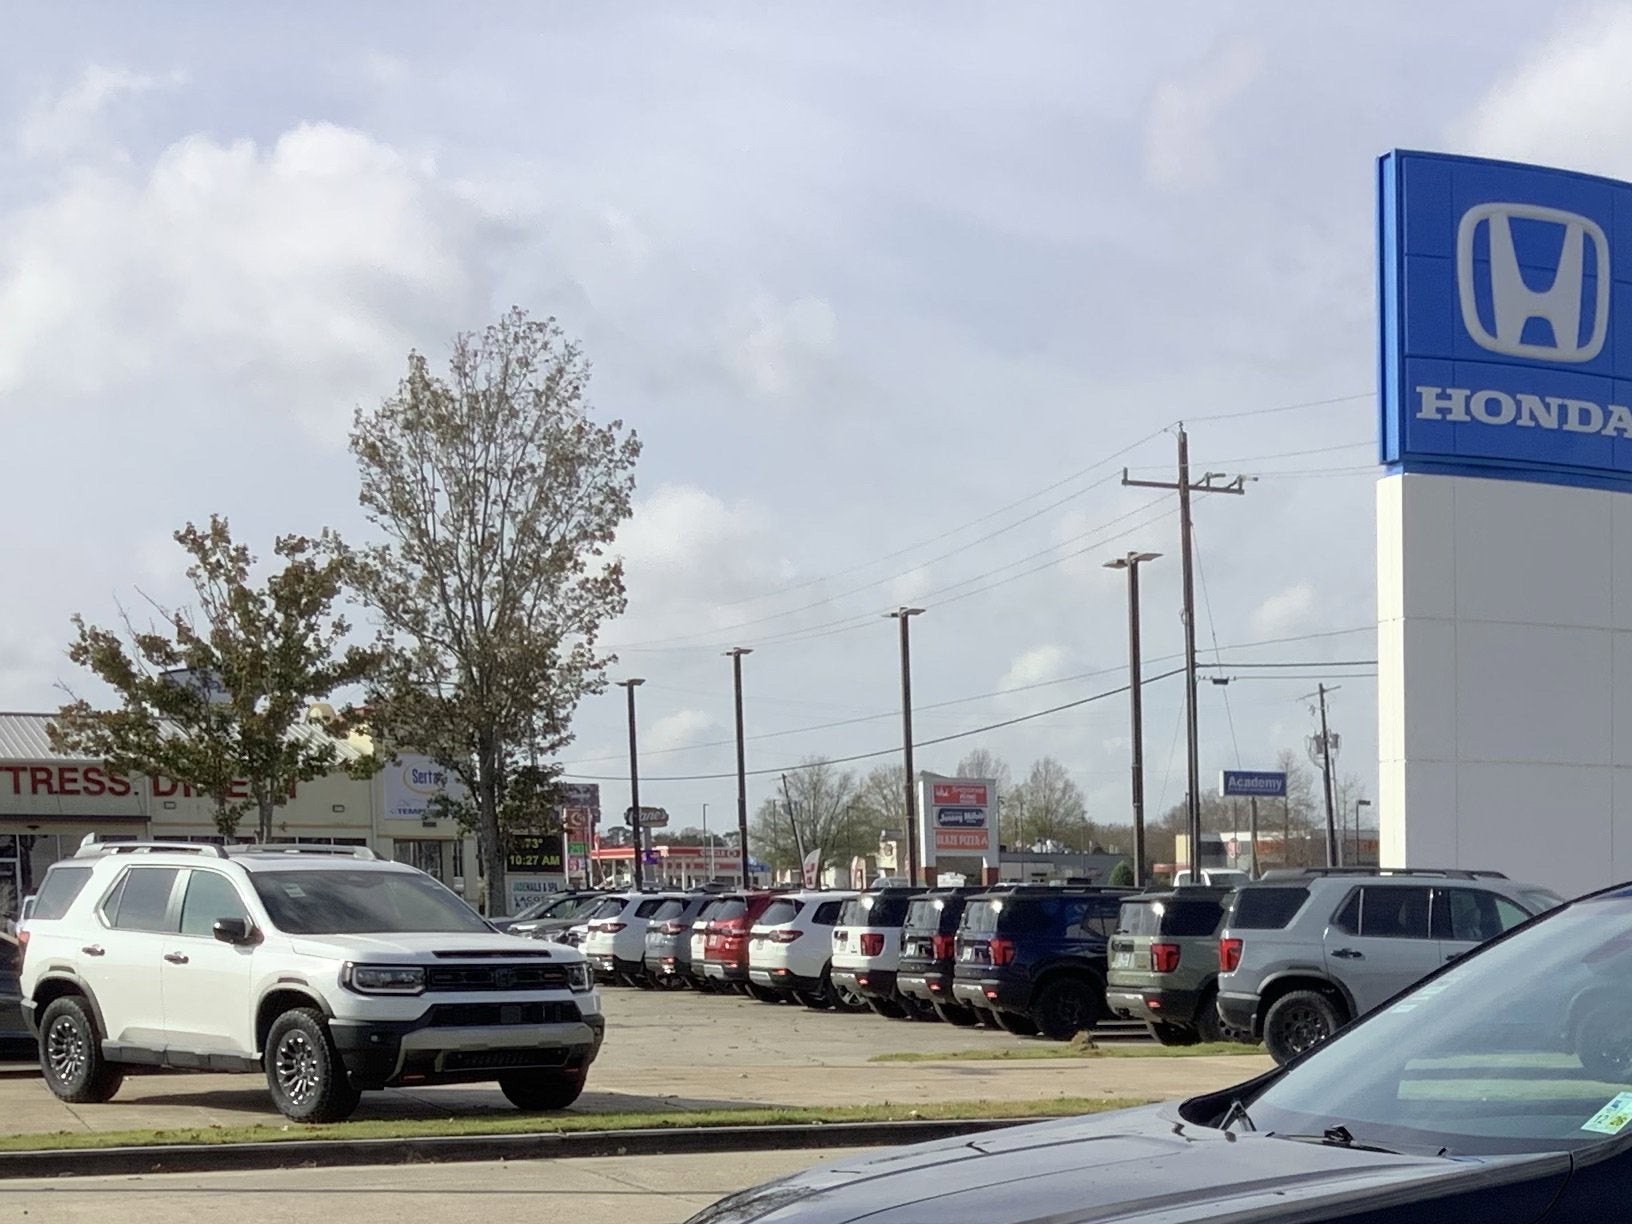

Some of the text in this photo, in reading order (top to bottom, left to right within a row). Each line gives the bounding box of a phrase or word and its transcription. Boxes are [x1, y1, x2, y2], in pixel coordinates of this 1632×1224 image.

[1228, 776, 1282, 791] Academy
[509, 855, 539, 866] 10:27
[541, 855, 561, 866] AM
